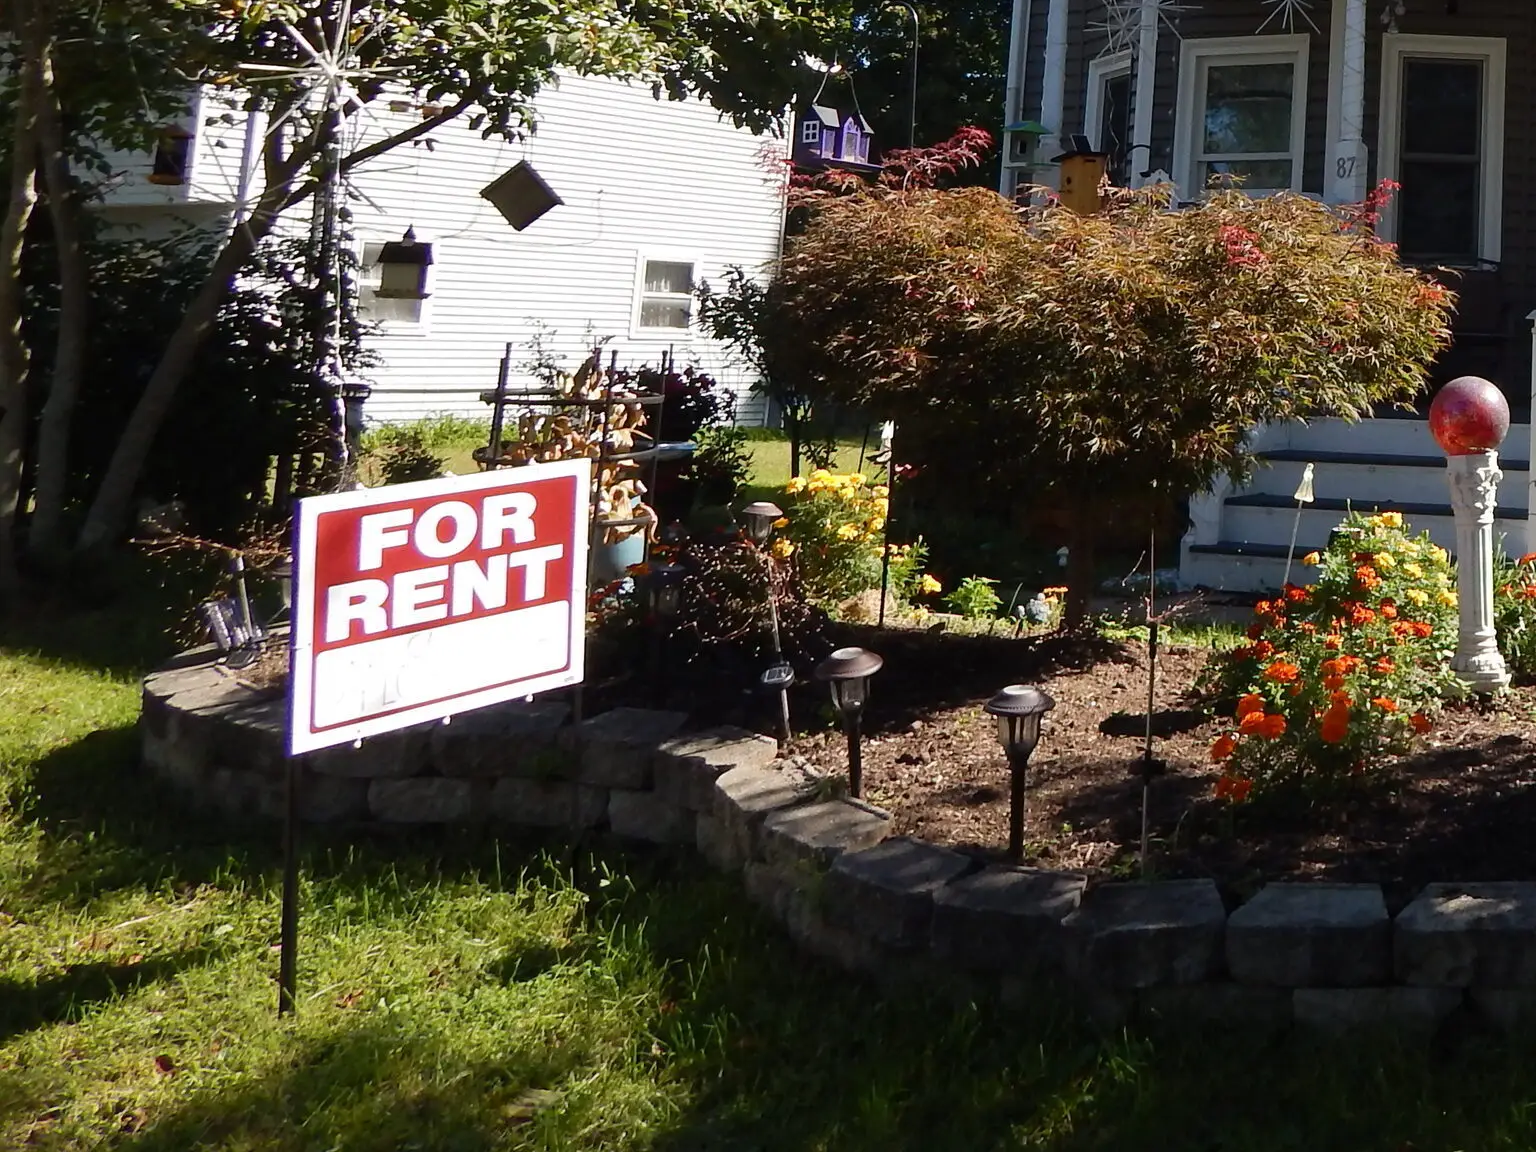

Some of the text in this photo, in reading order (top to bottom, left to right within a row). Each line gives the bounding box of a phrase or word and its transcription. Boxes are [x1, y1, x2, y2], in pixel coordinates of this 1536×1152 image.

[1336, 155, 1356, 179] 87
[358, 491, 537, 571] FOR
[325, 543, 563, 643] RENT
